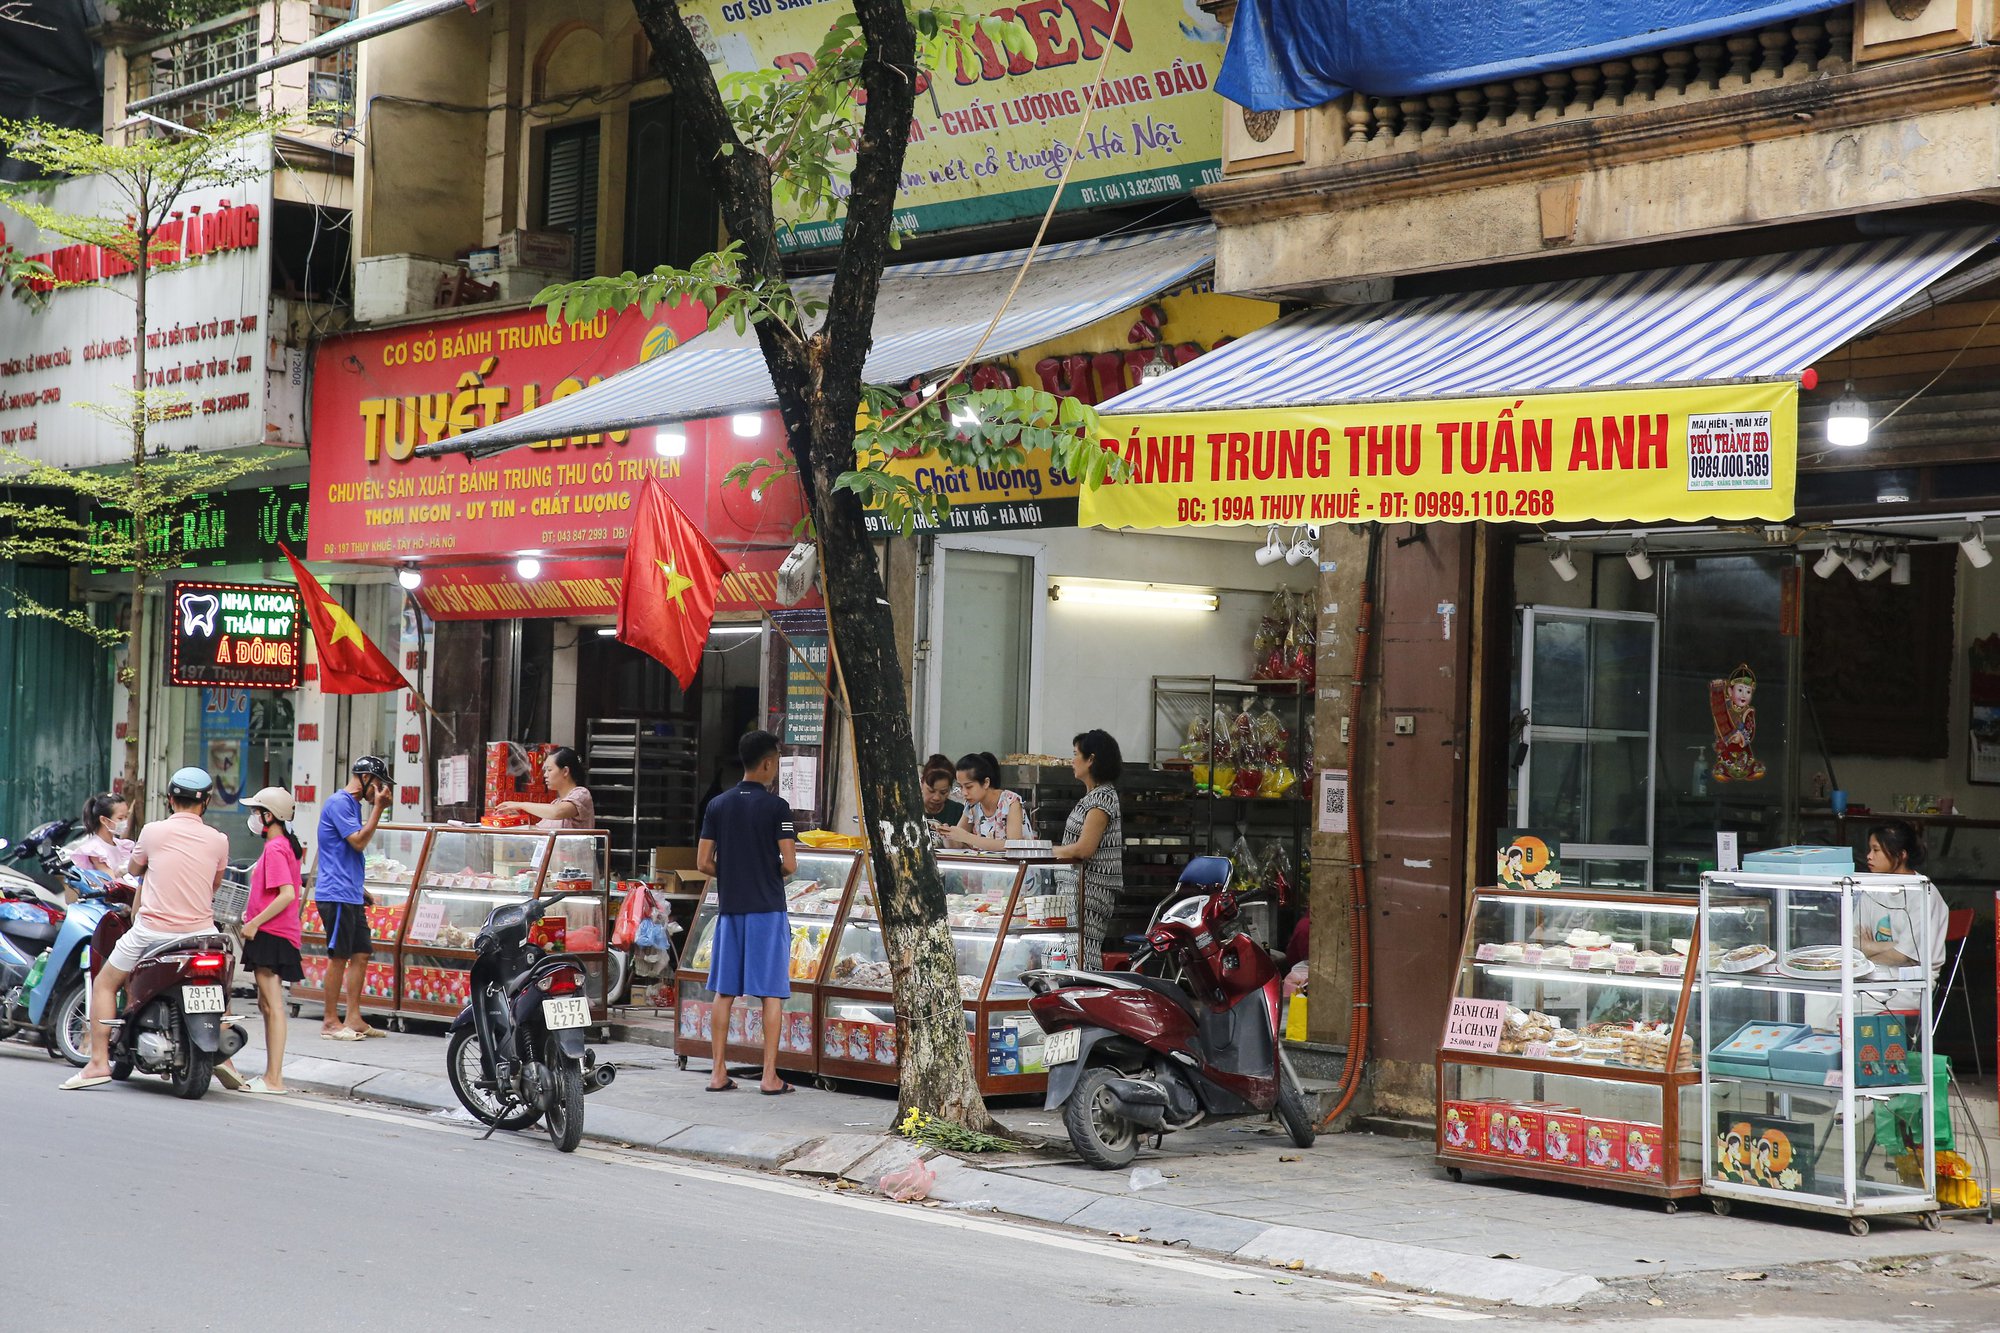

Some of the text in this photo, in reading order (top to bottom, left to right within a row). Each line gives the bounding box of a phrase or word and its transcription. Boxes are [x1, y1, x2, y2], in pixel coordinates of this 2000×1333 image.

[941, 57, 1208, 136] CHẤT LƯỢNG HÀNG ĐẦU
[1081, 187, 1099, 203] ĐT:
[1129, 174, 1181, 197] 3.8230798
[1201, 167, 1223, 185] 016
[383, 342, 408, 367] CƠ
[412, 329, 437, 363] SỞ
[441, 328, 492, 359] BÁNH
[497, 322, 562, 351] TRUNG
[1100, 400, 1669, 486] BÁNH TRUNG THU TUẤN ANH
[1690, 429, 1713, 455] PHÚ
[1714, 427, 1751, 453] THÀNH
[328, 476, 385, 503] CHUYÊN:
[387, 471, 414, 499] SẢN
[418, 467, 455, 496] XUẤT
[459, 466, 498, 494] BÁNH
[503, 465, 552, 490] TRUNG
[556, 463, 587, 486] THU
[591, 452, 613, 484] CỔ
[1691, 453, 1769, 479] 0989.000.589
[409, 504, 450, 523] NGON
[466, 502, 486, 520] UY
[490, 496, 516, 518] TÍN
[531, 490, 571, 516] CHẤT
[574, 491, 632, 518] LƯỢNG
[949, 507, 970, 528] TÂY
[973, 503, 989, 526] HỒ
[1000, 504, 1018, 525] HÀ
[1020, 503, 1043, 526] NỘI
[1177, 497, 1207, 522] ĐC:
[1212, 496, 1252, 521] 199A
[1310, 488, 1360, 519] KHUÊ
[1379, 492, 1409, 518] ĐT:
[1414, 489, 1554, 517] 0989.110.268
[557, 529, 571, 542] 043
[573, 528, 586, 541] 847
[588, 526, 608, 541] 2993
[338, 542, 349, 554] 197
[221, 592, 295, 613] NHA KHOA
[559, 578, 616, 607] TRUNG
[216, 635, 292, 666] Á ĐÔNG
[179, 664, 206, 680] 197
[252, 666, 290, 682] Khuê
[187, 999, 221, 1011] 481.21
[189, 987, 217, 999] 29-F1
[550, 1000, 581, 1014] 30-F7
[1453, 1001, 1499, 1020] BÁNH CHẢ
[553, 1013, 585, 1028] 4273
[1450, 1019, 1498, 1038] LÁ CHANH
[1049, 1031, 1074, 1049] 29-F1
